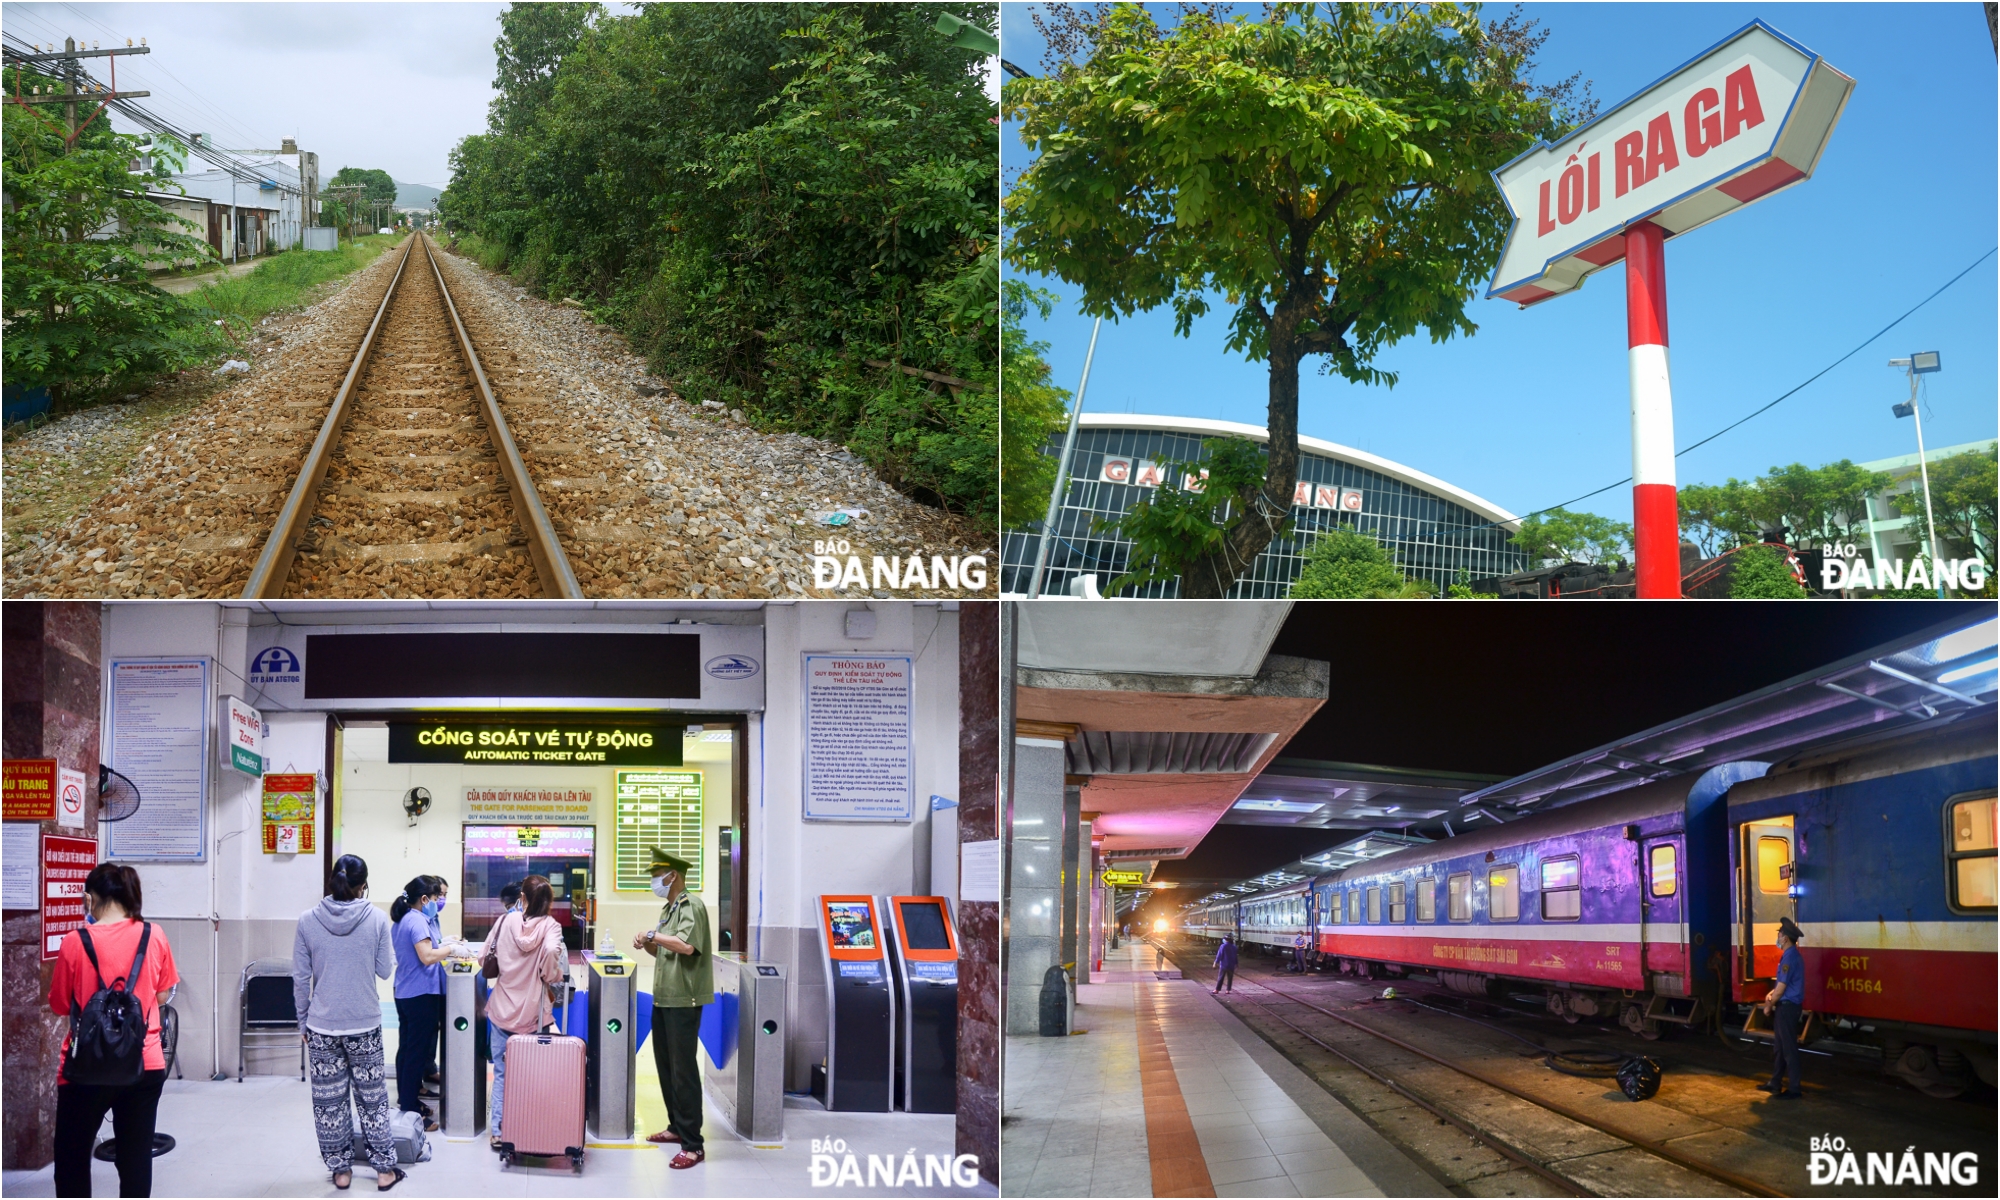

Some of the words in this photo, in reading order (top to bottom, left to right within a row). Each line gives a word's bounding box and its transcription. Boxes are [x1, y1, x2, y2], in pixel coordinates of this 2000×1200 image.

[1538, 140, 1600, 238] LỐI
[1614, 110, 1680, 200] RA
[1684, 64, 1766, 158] GA
[1105, 460, 1160, 486] GA
[832, 660, 864, 670] THÔNG
[866, 660, 886, 670] BÁO
[233, 708, 246, 726] Free
[239, 729, 254, 747] Zone
[418, 726, 474, 745] CỔNG
[478, 729, 531, 746] SOÁT
[535, 729, 560, 746] VÉ
[564, 730, 593, 749] TỰ
[596, 729, 653, 750] ĐỘNG
[464, 751, 529, 760] AUTOMATIC
[532, 751, 573, 760] TICKET
[575, 752, 606, 761] GATE
[22, 764, 50, 774] KHÁCH
[18, 780, 48, 790] TRANG
[467, 788, 480, 801] CỬA
[482, 789, 496, 801] ĐÓN
[514, 789, 536, 801] KHÁCH
[538, 789, 552, 801] VÀO
[553, 791, 562, 801] GA
[564, 790, 577, 802] LÊN
[578, 790, 592, 802] TÀU
[283, 829, 293, 840] 29
[60, 884, 84, 896] 1,32M
[1606, 946, 1620, 956] SRT
[1840, 956, 1870, 970] SRT
